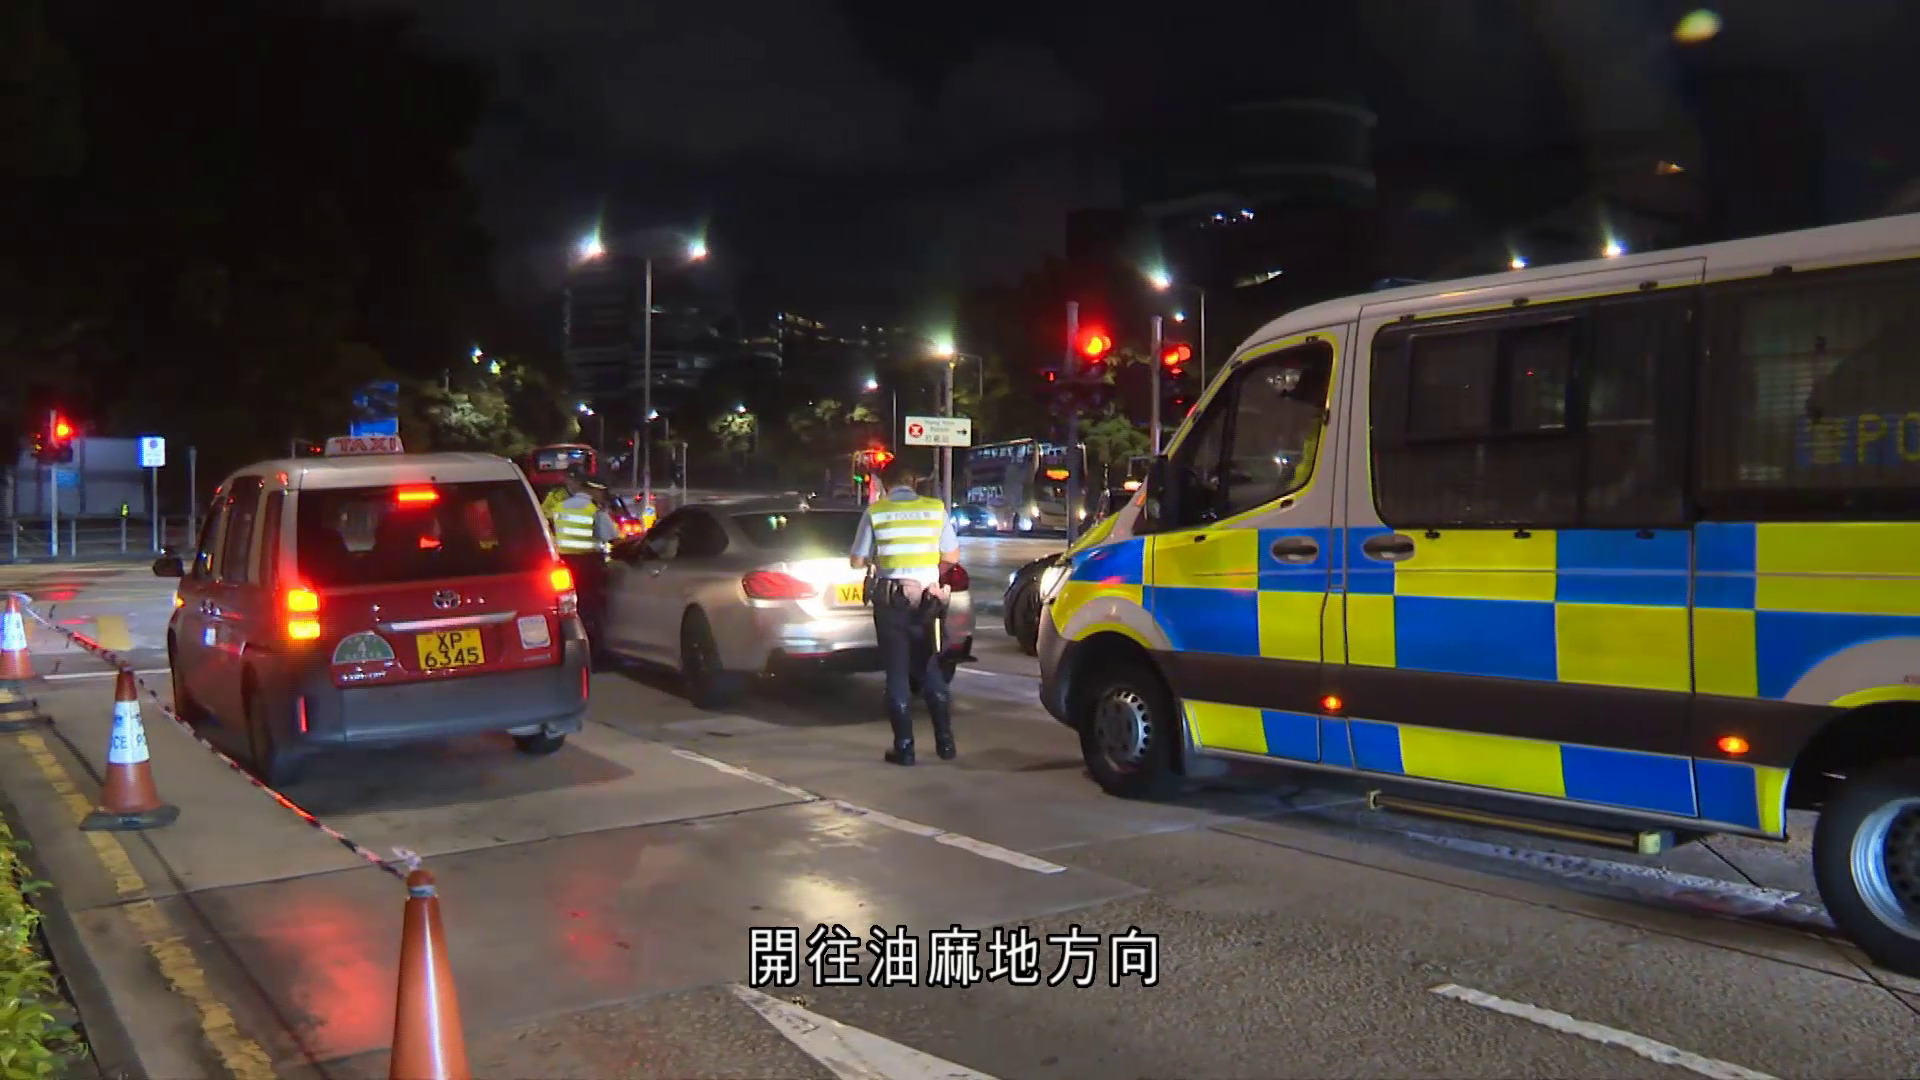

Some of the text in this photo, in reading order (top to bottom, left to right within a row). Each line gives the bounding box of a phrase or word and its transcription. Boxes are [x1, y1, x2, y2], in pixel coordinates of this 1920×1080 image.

[335, 437, 397, 451] TAXI
[437, 632, 462, 650] XP
[425, 647, 479, 667] 6345
